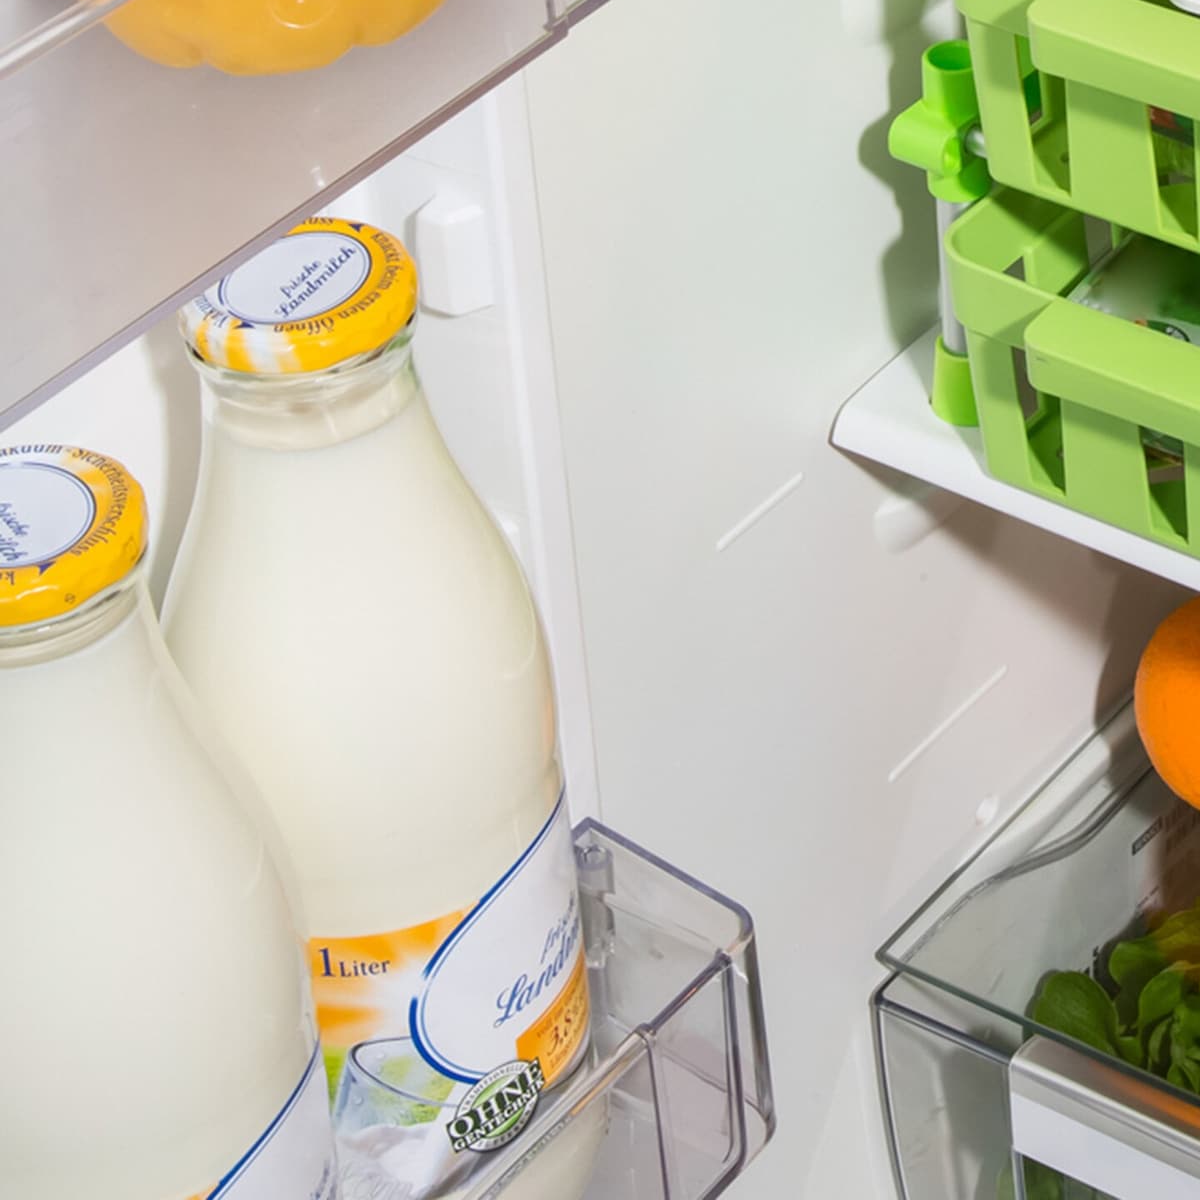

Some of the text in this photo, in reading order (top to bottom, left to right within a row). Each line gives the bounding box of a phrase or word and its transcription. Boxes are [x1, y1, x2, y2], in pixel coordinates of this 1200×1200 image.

[273, 244, 357, 318] Landmilch
[273, 318, 335, 335] Öffnen
[318, 947, 391, 979] 1 Liter
[449, 1059, 540, 1139] OHNE
[453, 1069, 546, 1151] GENTECHNIK
